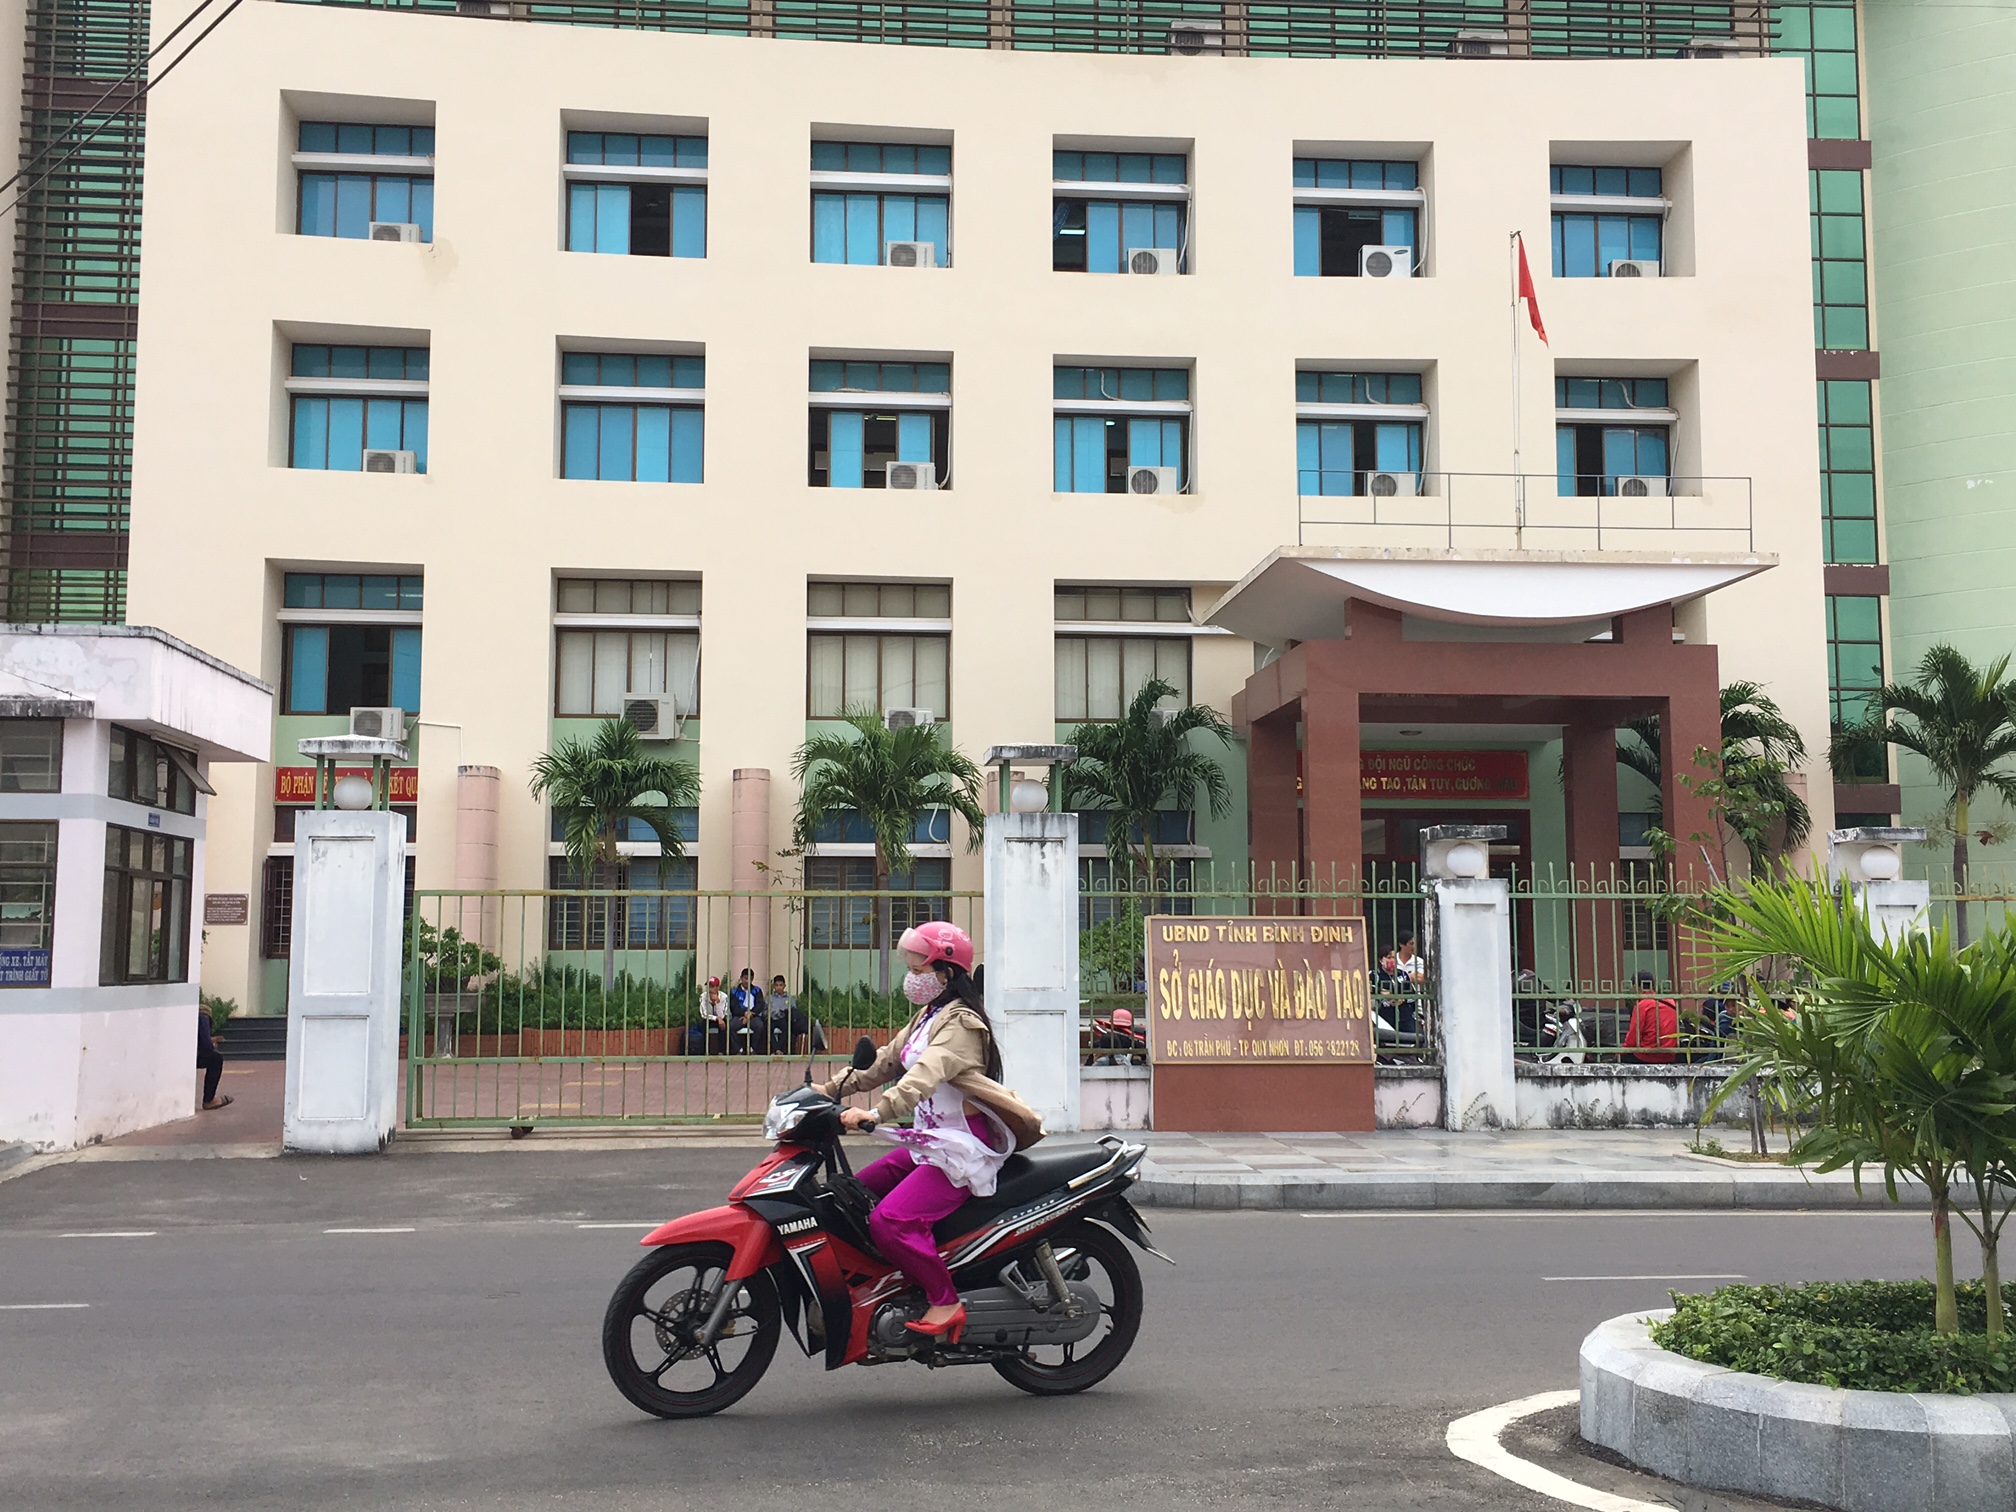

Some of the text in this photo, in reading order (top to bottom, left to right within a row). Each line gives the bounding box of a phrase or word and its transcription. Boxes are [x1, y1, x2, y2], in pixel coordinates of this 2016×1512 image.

[1389, 755, 1410, 771] NGŨ
[1414, 755, 1443, 770] CÔNG
[280, 771, 291, 797] BỘ
[293, 772, 314, 797] PHẬN
[405, 776, 418, 797] QU
[1162, 920, 1353, 946] UBND TỈNH BÌNH ĐỊNH
[1159, 948, 1365, 1031] SỞ GIÁO DỤC VÀ ĐÀO TẠO
[1194, 1033, 1215, 1057] TRẦN
[1215, 1035, 1231, 1056] PHÚ
[1252, 1040, 1267, 1056] QUY
[777, 1216, 818, 1235] YAMAHA
